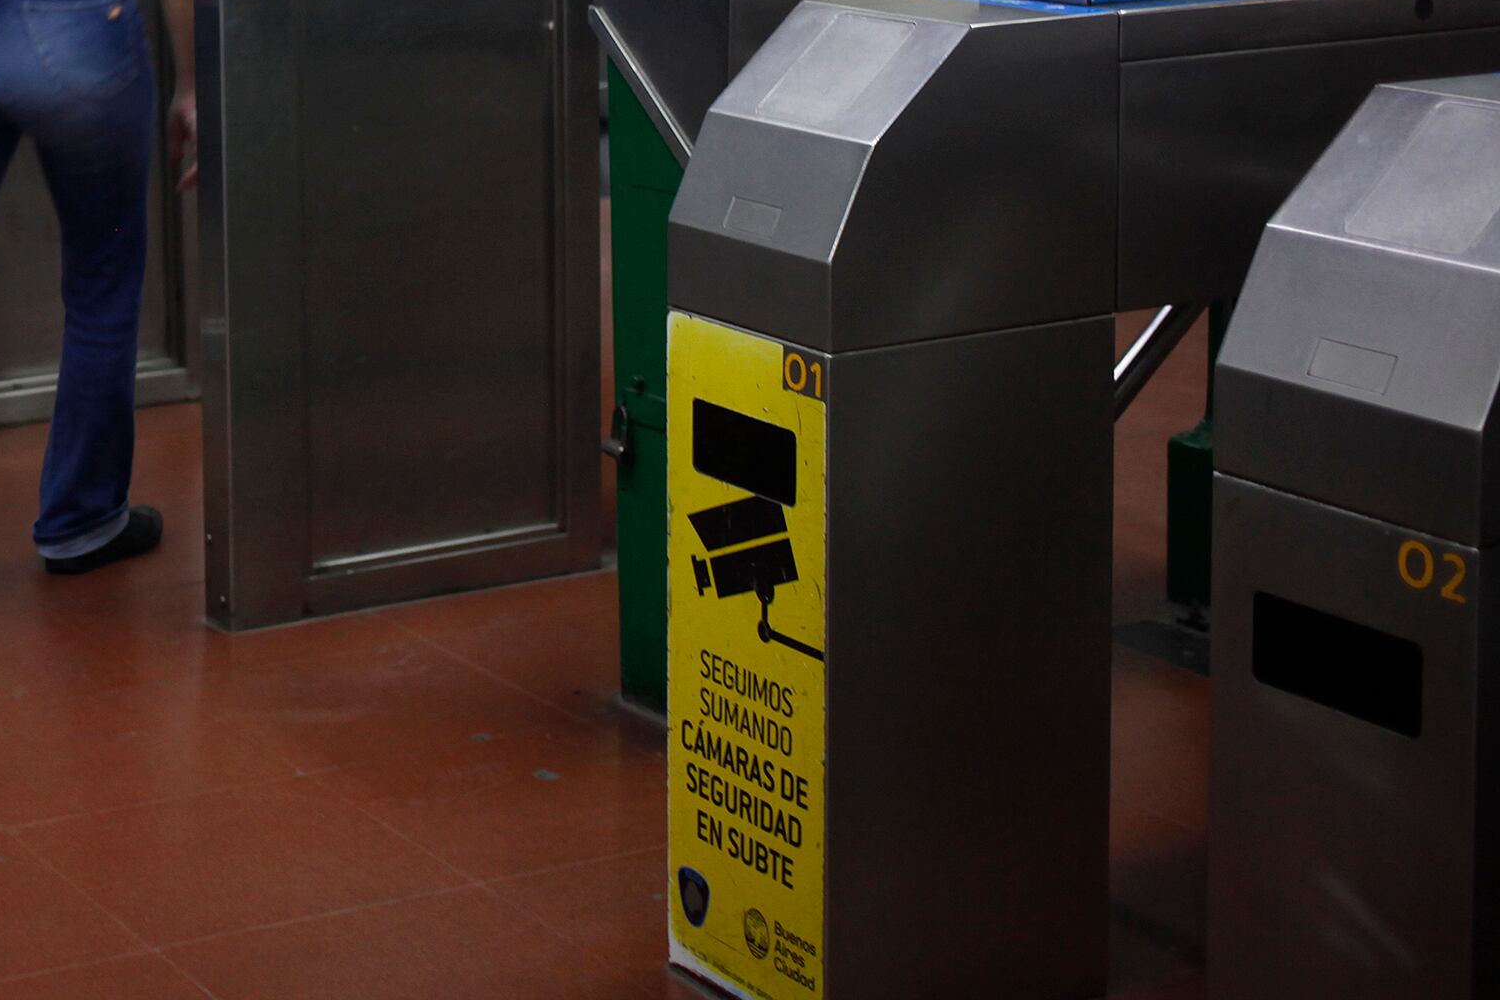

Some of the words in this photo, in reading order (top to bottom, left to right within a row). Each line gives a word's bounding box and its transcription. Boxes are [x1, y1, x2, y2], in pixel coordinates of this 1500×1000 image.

[784, 352, 822, 398] 01
[1398, 540, 1467, 605] 02
[700, 649, 794, 718] SEGUIMOS
[700, 688, 792, 756] SUMANDO
[681, 719, 775, 792] CÁMARAS
[781, 768, 809, 811] DE
[686, 763, 802, 848] SEGURIDAD
[697, 810, 722, 851] EN
[728, 827, 794, 889] SUBTE
[774, 921, 816, 956] Buenos
[774, 940, 805, 968] Aires
[773, 956, 815, 991] Ciudad
